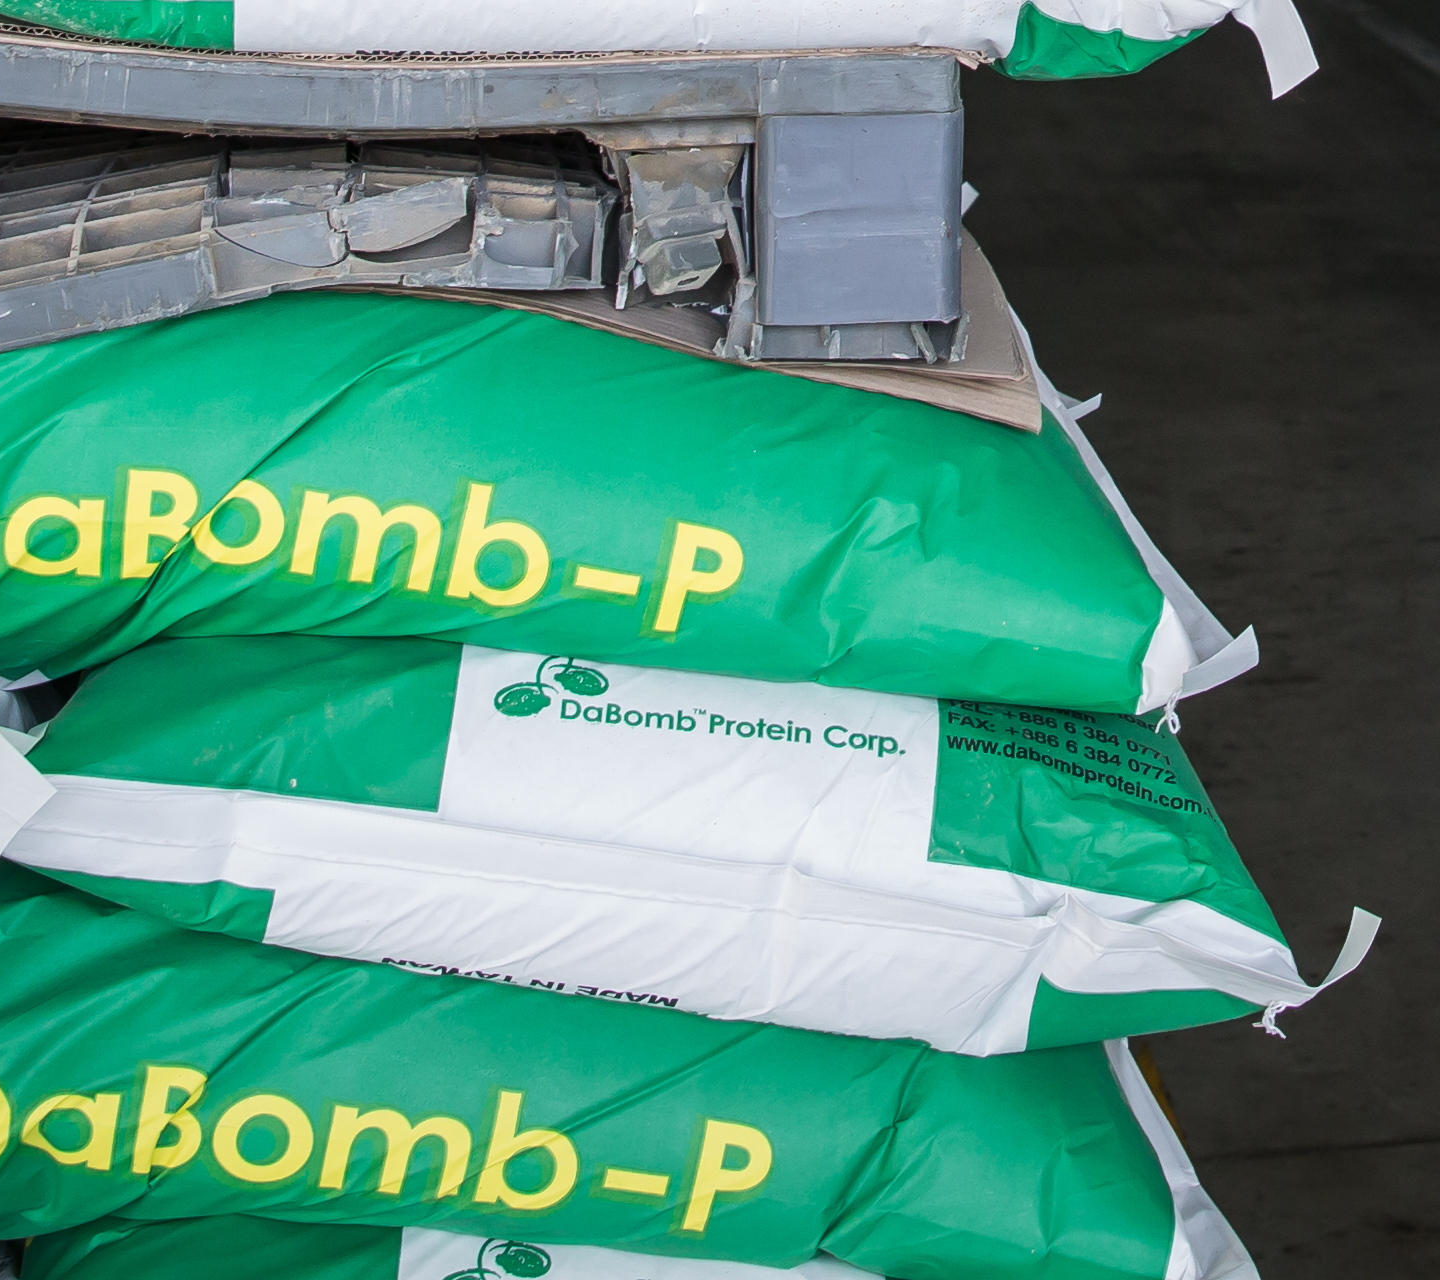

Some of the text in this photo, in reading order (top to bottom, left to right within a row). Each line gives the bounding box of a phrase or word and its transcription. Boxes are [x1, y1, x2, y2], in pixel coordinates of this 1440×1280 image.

[708, 712, 813, 745] Protein
[822, 724, 908, 759] Corp.
[947, 710, 1178, 786] FAX: +886 6 384 0772
[1001, 708, 1059, 730] +886
[1062, 721, 1078, 736] 6
[1082, 724, 1121, 748] 384
[1125, 738, 1172, 767] 0771
[945, 734, 1218, 823] www.dabombprotein.com.
[528, 978, 566, 992] IN
[574, 984, 680, 1009] MADE
